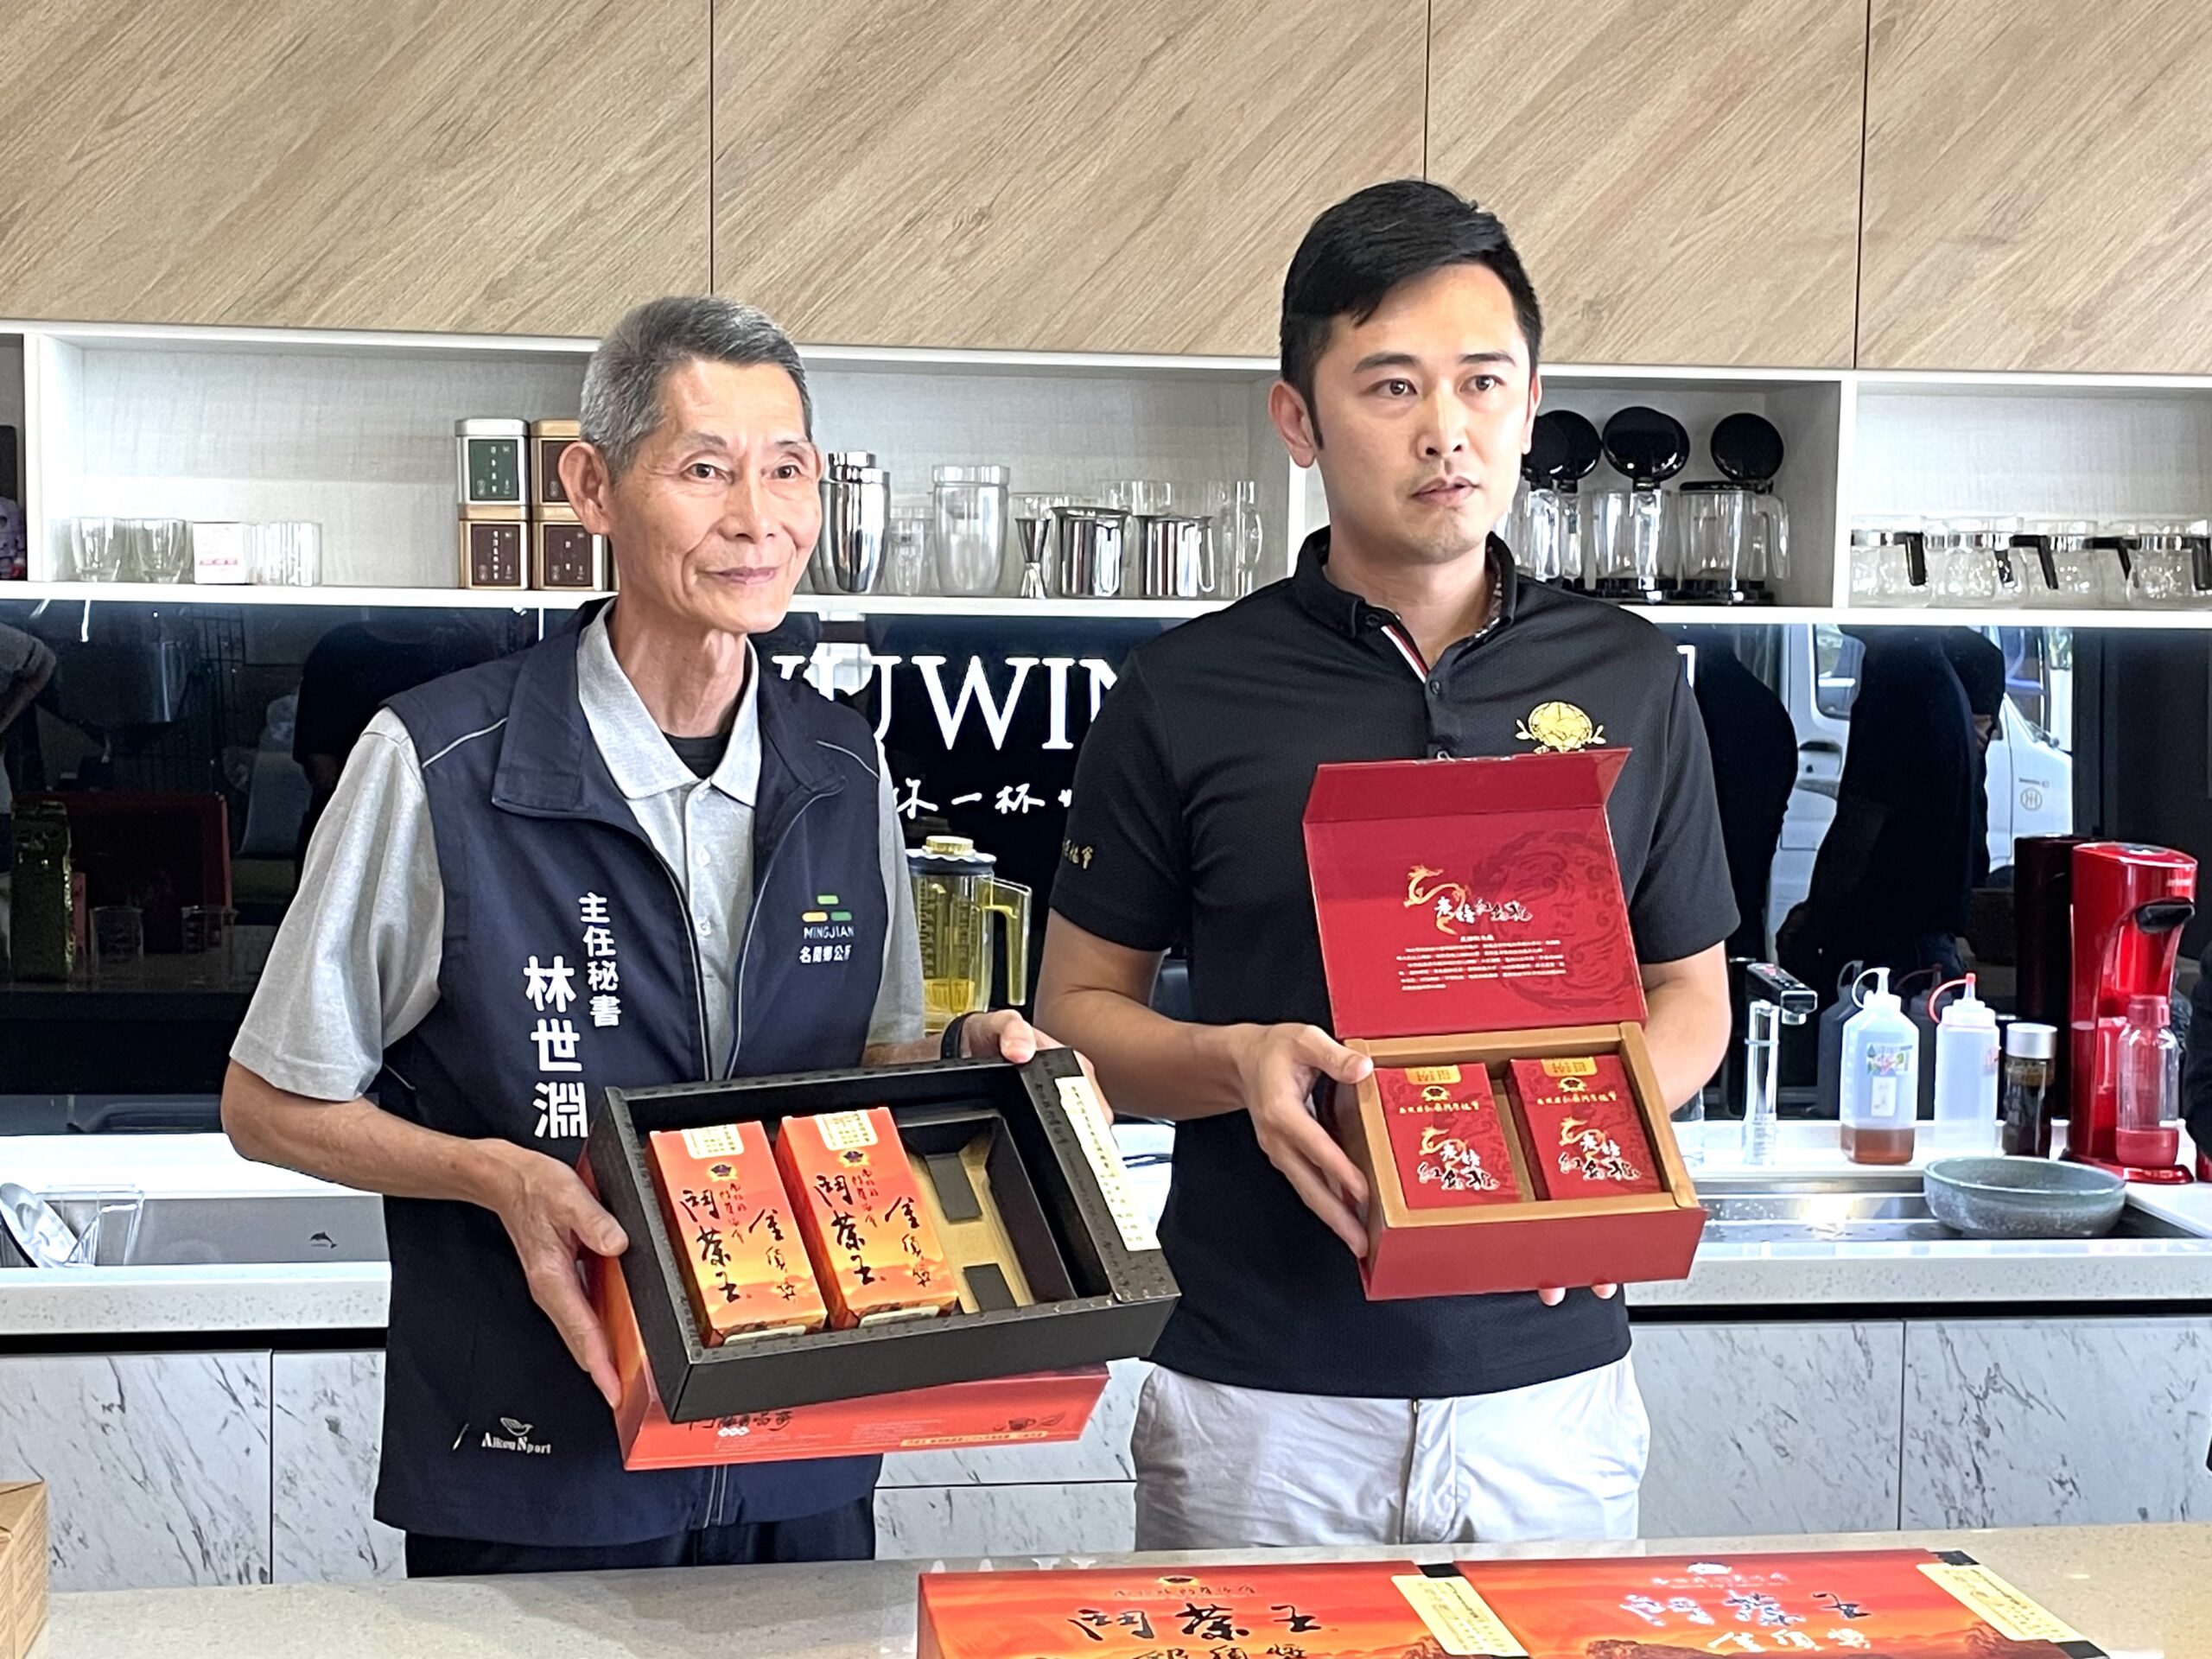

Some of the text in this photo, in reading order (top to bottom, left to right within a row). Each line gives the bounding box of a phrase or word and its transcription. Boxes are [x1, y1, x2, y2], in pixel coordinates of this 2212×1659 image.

[771, 654, 1118, 750] UWI
[578, 892, 621, 1027] 主任秘書
[803, 925, 855, 939] MINGJIAN
[523, 956, 589, 1139] 林世淵
